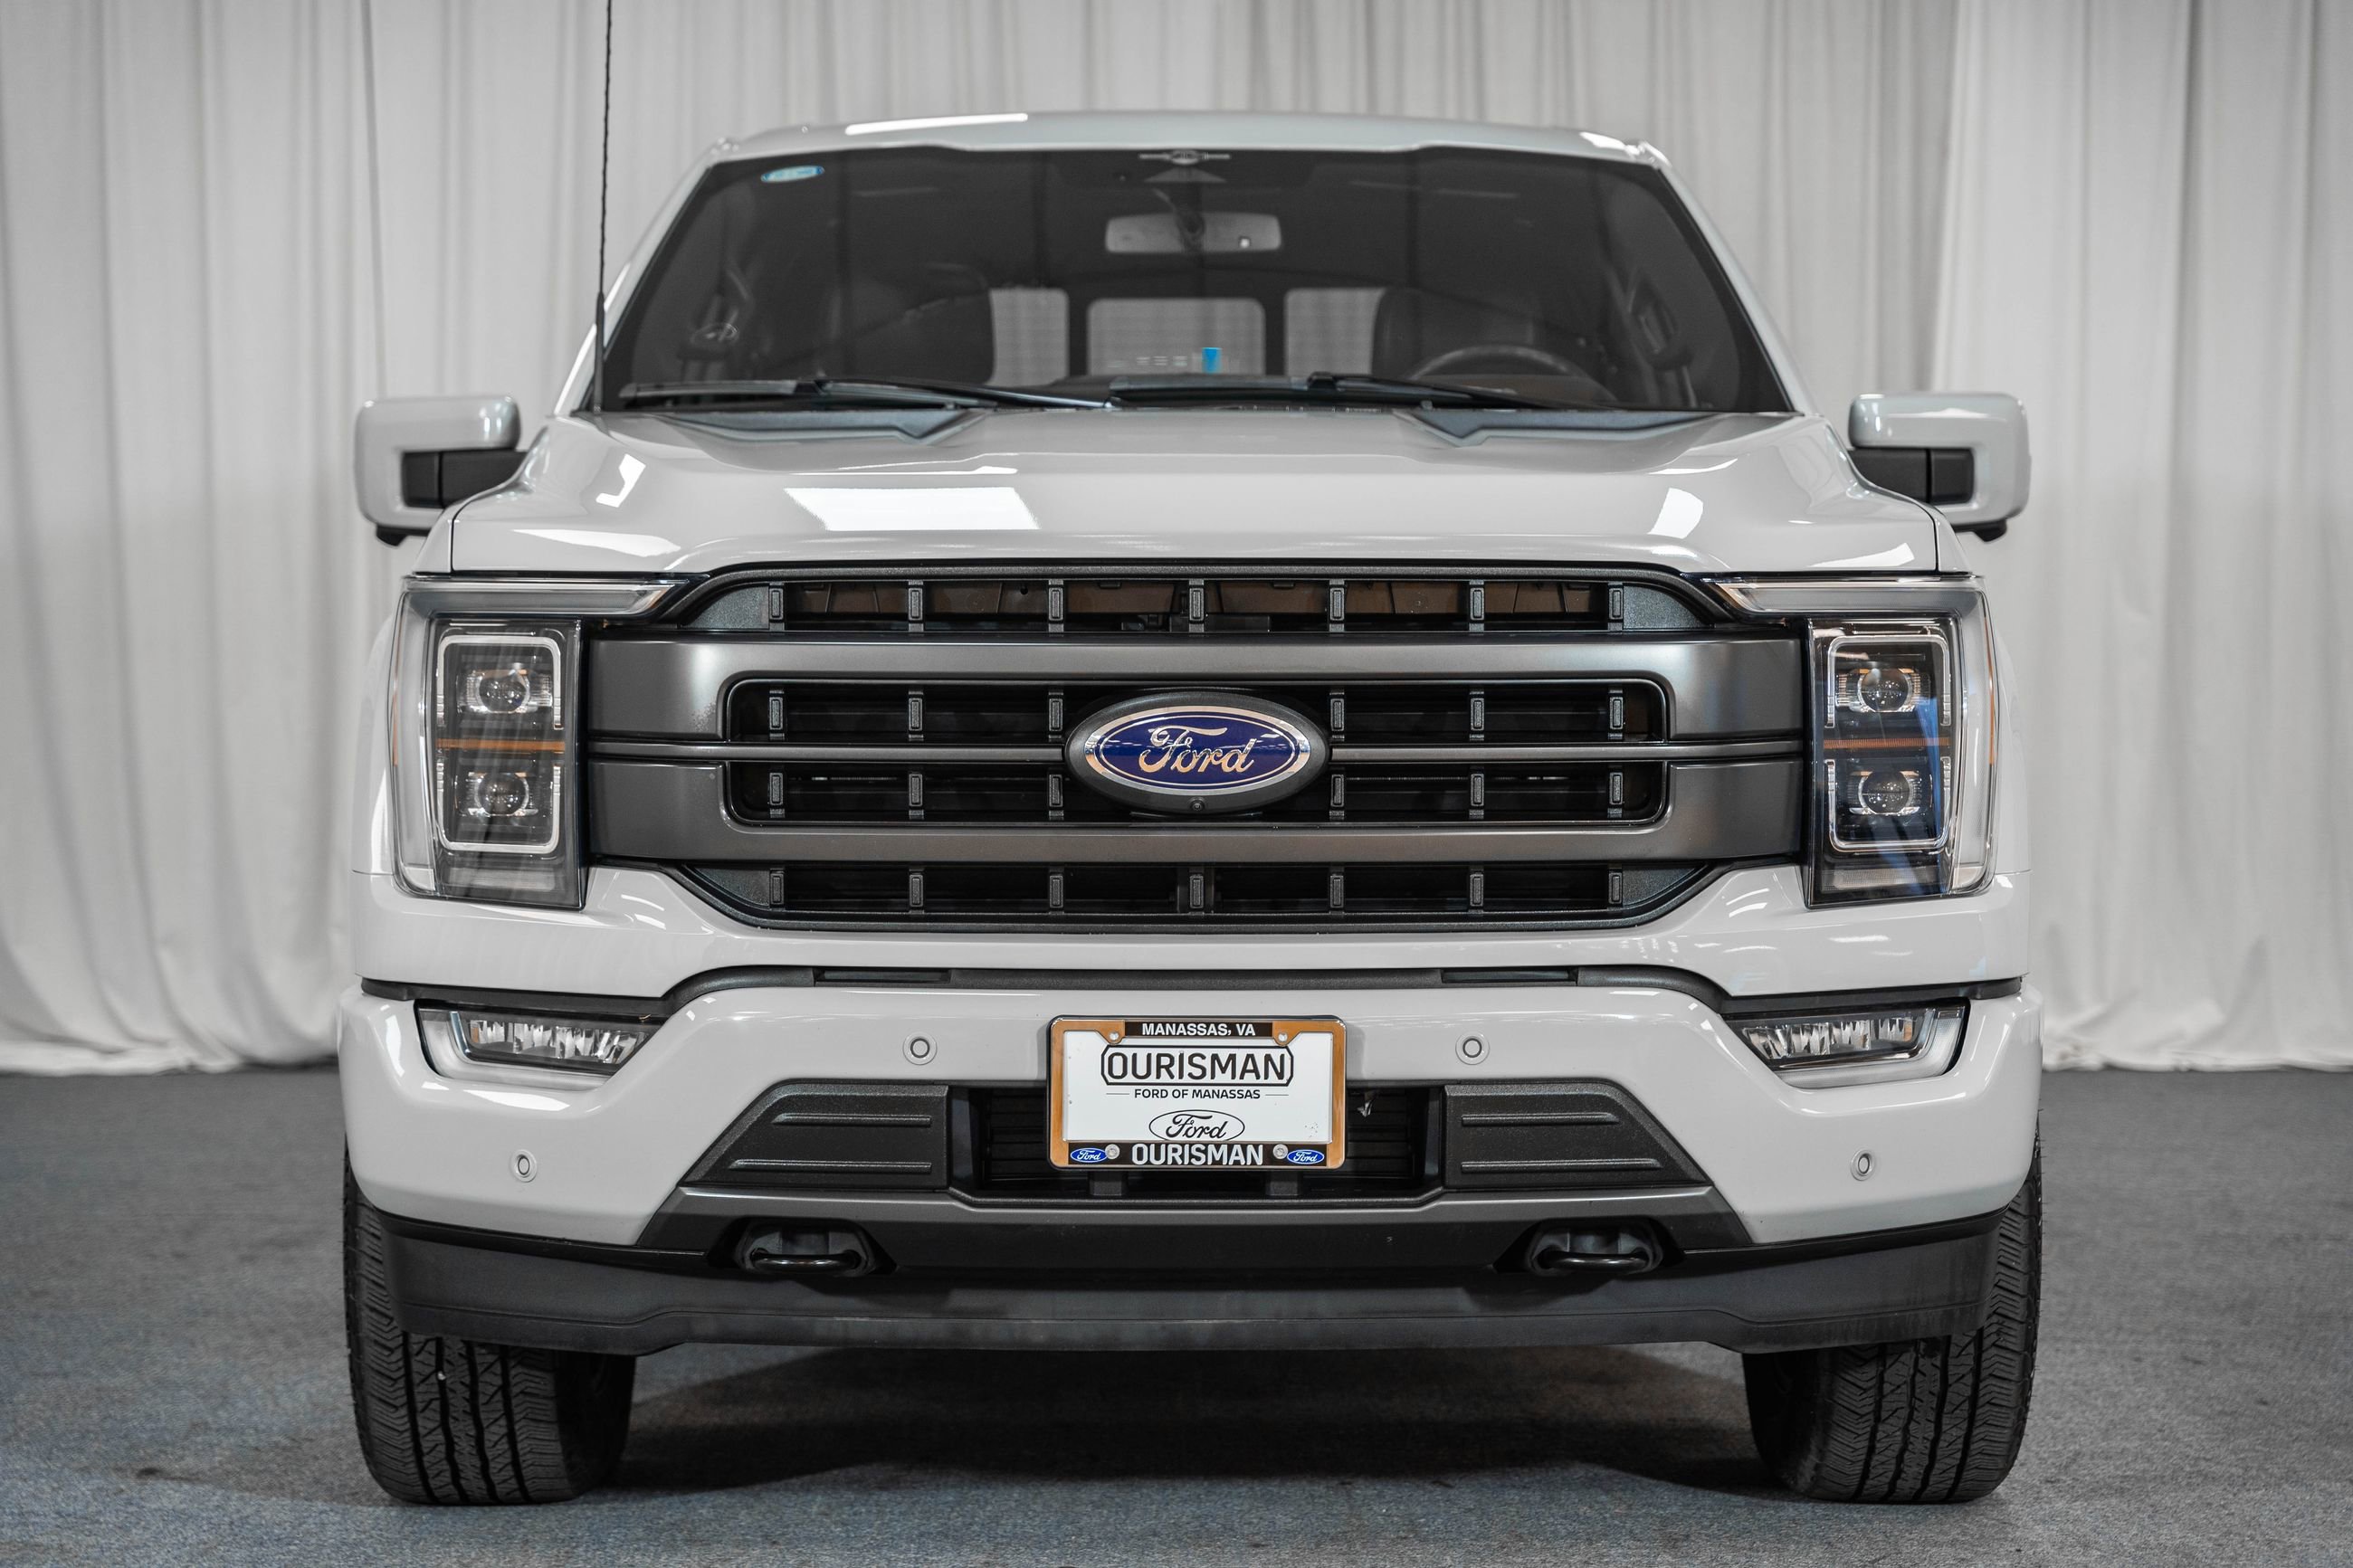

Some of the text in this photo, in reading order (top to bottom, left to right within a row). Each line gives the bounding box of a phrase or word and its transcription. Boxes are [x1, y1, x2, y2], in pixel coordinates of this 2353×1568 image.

[1138, 725, 1257, 773] Ford
[1142, 1022, 1256, 1036] MANASSAS, VA
[1107, 1052, 1286, 1080] OURISMAN
[1134, 1088, 1261, 1099] FORD OF MANASSAS
[1165, 1113, 1228, 1139] Ford
[1076, 1149, 1102, 1161] Ford
[1131, 1143, 1264, 1165] OURISMAN
[1292, 1151, 1319, 1163] Ford
